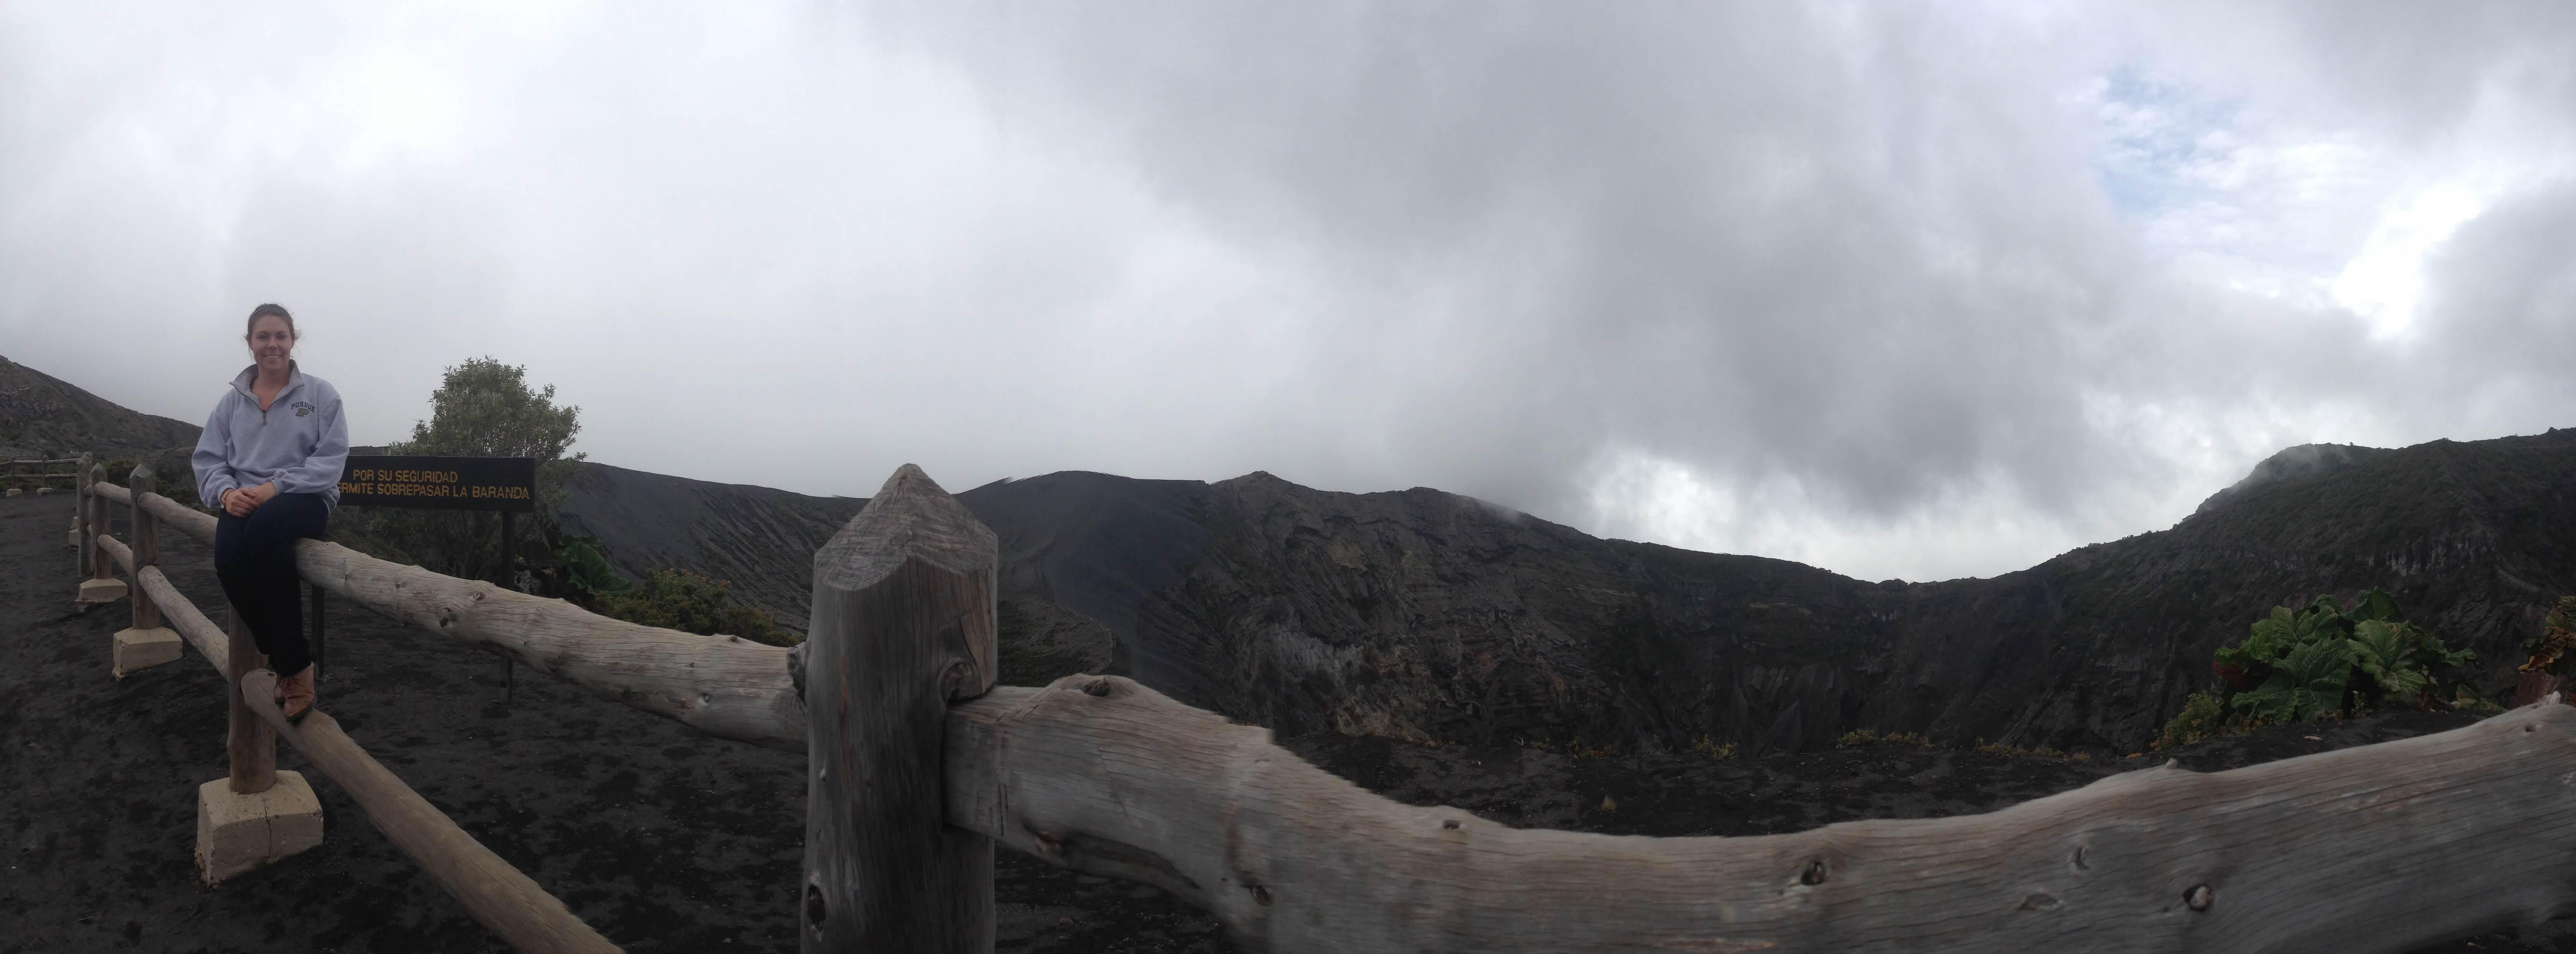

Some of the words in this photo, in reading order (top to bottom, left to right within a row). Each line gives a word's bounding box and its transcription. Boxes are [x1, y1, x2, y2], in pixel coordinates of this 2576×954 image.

[291, 402, 315, 412] PURDUE
[353, 469, 374, 481] POR
[378, 469, 392, 481] SU
[396, 470, 458, 483] SEGURIDAD
[337, 482, 373, 494] ERMITE
[377, 483, 449, 497] SOBREPASAR
[453, 486, 468, 498] LA
[472, 486, 529, 499] BARANDA
